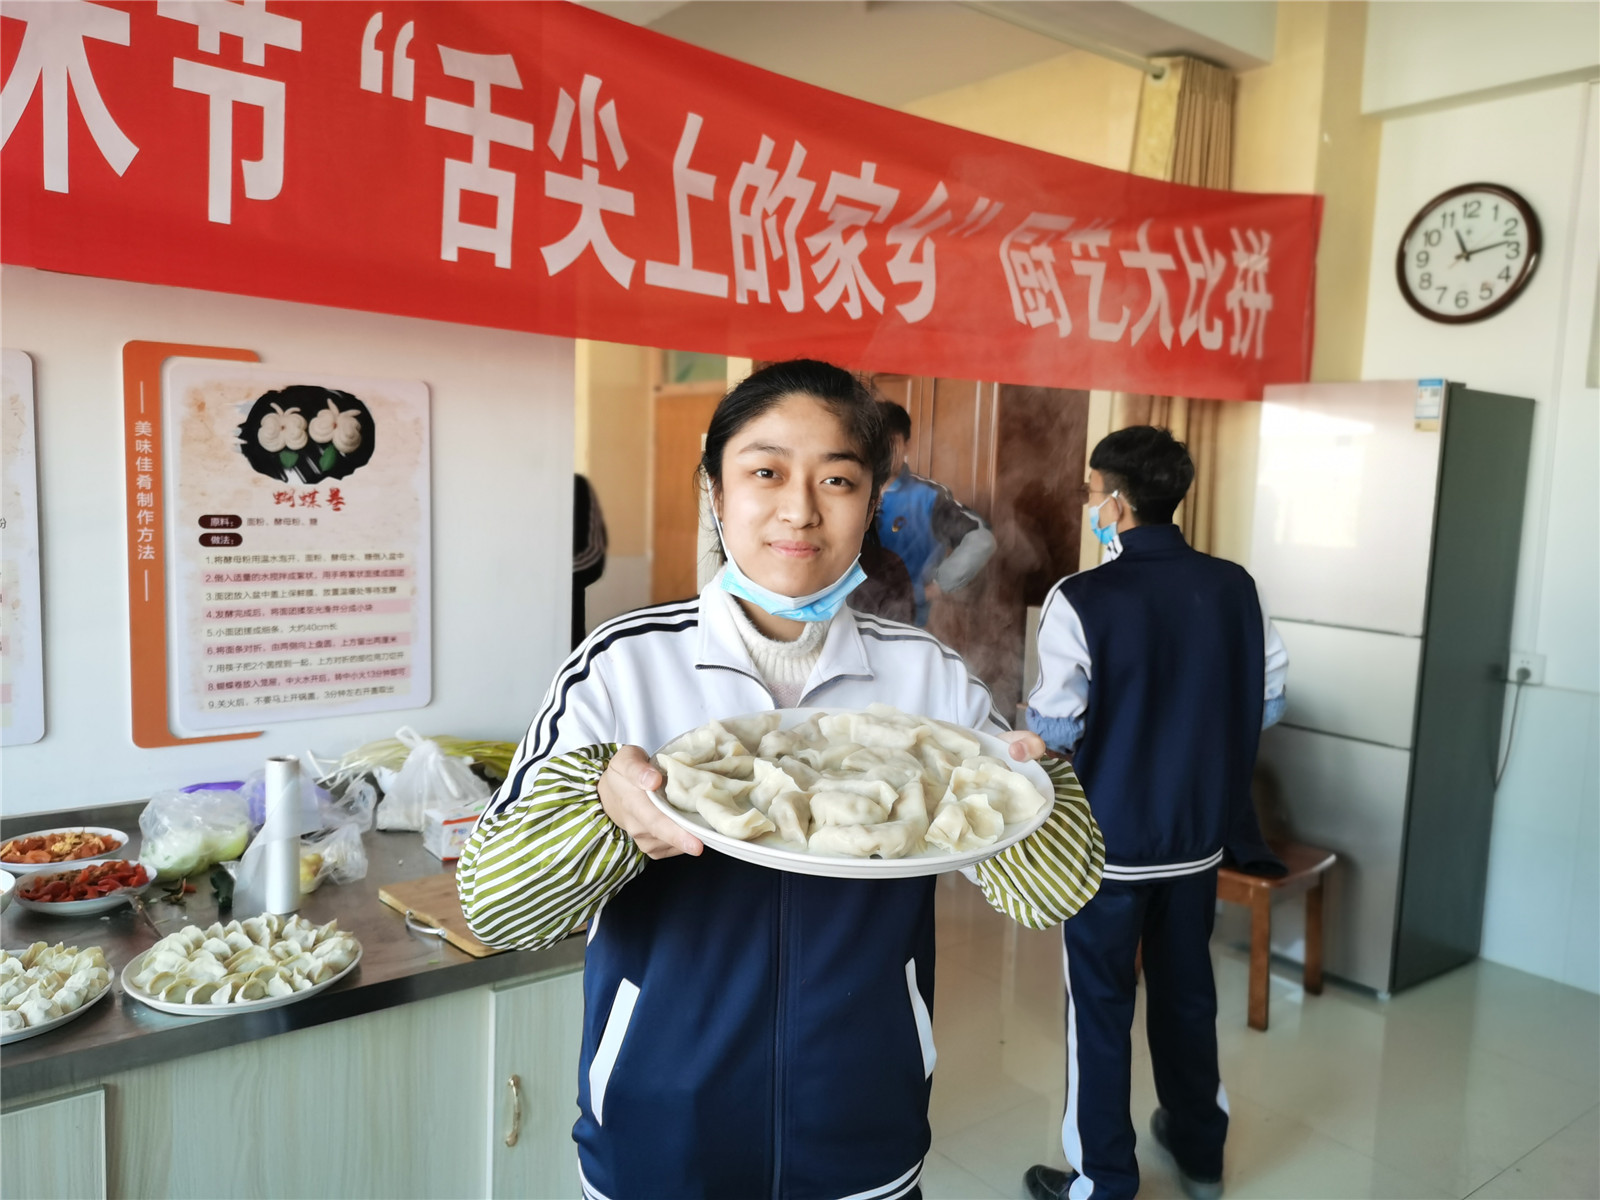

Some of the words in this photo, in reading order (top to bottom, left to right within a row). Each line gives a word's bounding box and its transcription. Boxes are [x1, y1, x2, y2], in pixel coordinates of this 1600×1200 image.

[1463, 200, 1481, 219] 12
[1492, 204, 1499, 221] 1
[1441, 211, 1455, 229] 11
[1503, 218, 1518, 236] 2
[1424, 229, 1441, 247] 10
[1416, 251, 1430, 268] 9
[1505, 241, 1520, 260] 3
[1419, 272, 1432, 290] 8
[1497, 265, 1511, 282] 4
[1435, 286, 1447, 304] 7
[1455, 291, 1468, 309] 6
[1479, 282, 1493, 300] 5
[134, 420, 155, 560] 美味佳肴制作方法
